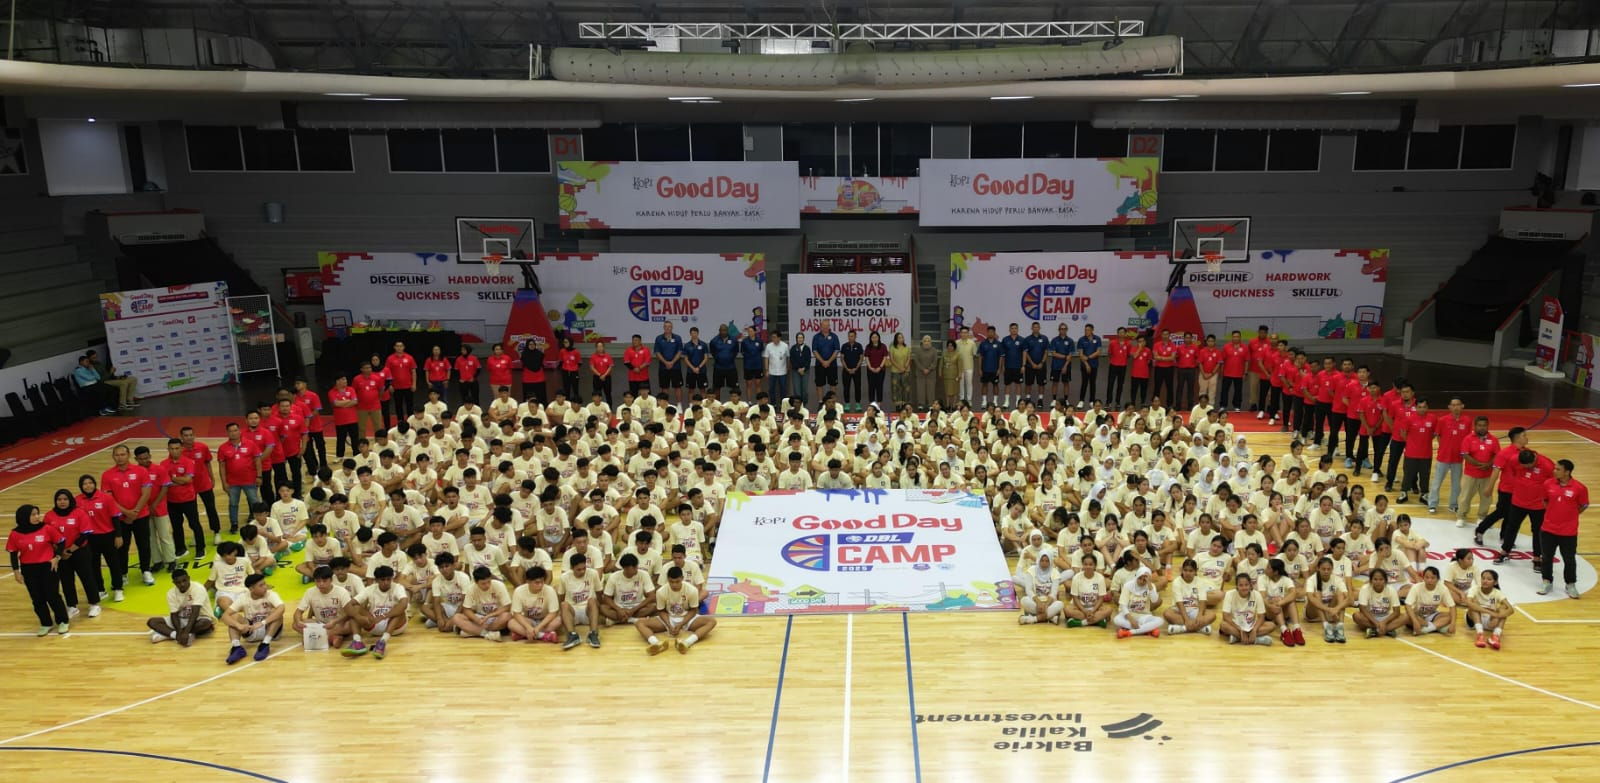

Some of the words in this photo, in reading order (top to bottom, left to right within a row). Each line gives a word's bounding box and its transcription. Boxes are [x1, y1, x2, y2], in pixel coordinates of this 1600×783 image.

[555, 137, 578, 155] D1
[1132, 137, 1159, 154] D2
[656, 176, 714, 198] Good
[716, 176, 760, 203] Day
[973, 173, 1030, 196] Good
[1032, 173, 1075, 200] Day
[951, 207, 981, 215] KARENA
[982, 207, 1003, 215] HIDUP
[370, 275, 430, 285] DISCIPLINE
[448, 275, 515, 285] HARDWORK
[630, 265, 671, 281] Good
[673, 266, 704, 285] Day
[1025, 264, 1066, 281] Good
[1067, 264, 1098, 284] Day
[1189, 273, 1249, 283] DISCIPLINE
[1265, 272, 1332, 282] HARDWORK
[396, 291, 461, 301] QUICKNESS
[477, 291, 516, 300] SKILLF
[813, 282, 885, 298] INDONESIA'S
[1212, 288, 1275, 298] QUICKNESS
[1292, 288, 1340, 297] SKILLFUL
[651, 298, 700, 315] CAMP
[806, 298, 833, 306] BEST
[834, 298, 843, 306] &
[845, 298, 892, 306] BIGGEST
[1042, 297, 1092, 314] CAMP
[813, 308, 841, 317] HIGH
[843, 308, 888, 317] SCHOOL
[800, 318, 864, 333] BASTBALL
[868, 317, 900, 333] CAMP
[791, 514, 887, 530] Good
[890, 513, 963, 532] Day
[864, 534, 901, 543] DBL
[837, 544, 957, 565] CAMP
[915, 713, 1081, 723] Investment
[1002, 727, 1086, 737] Kalila
[994, 741, 1092, 752] Bakrie
